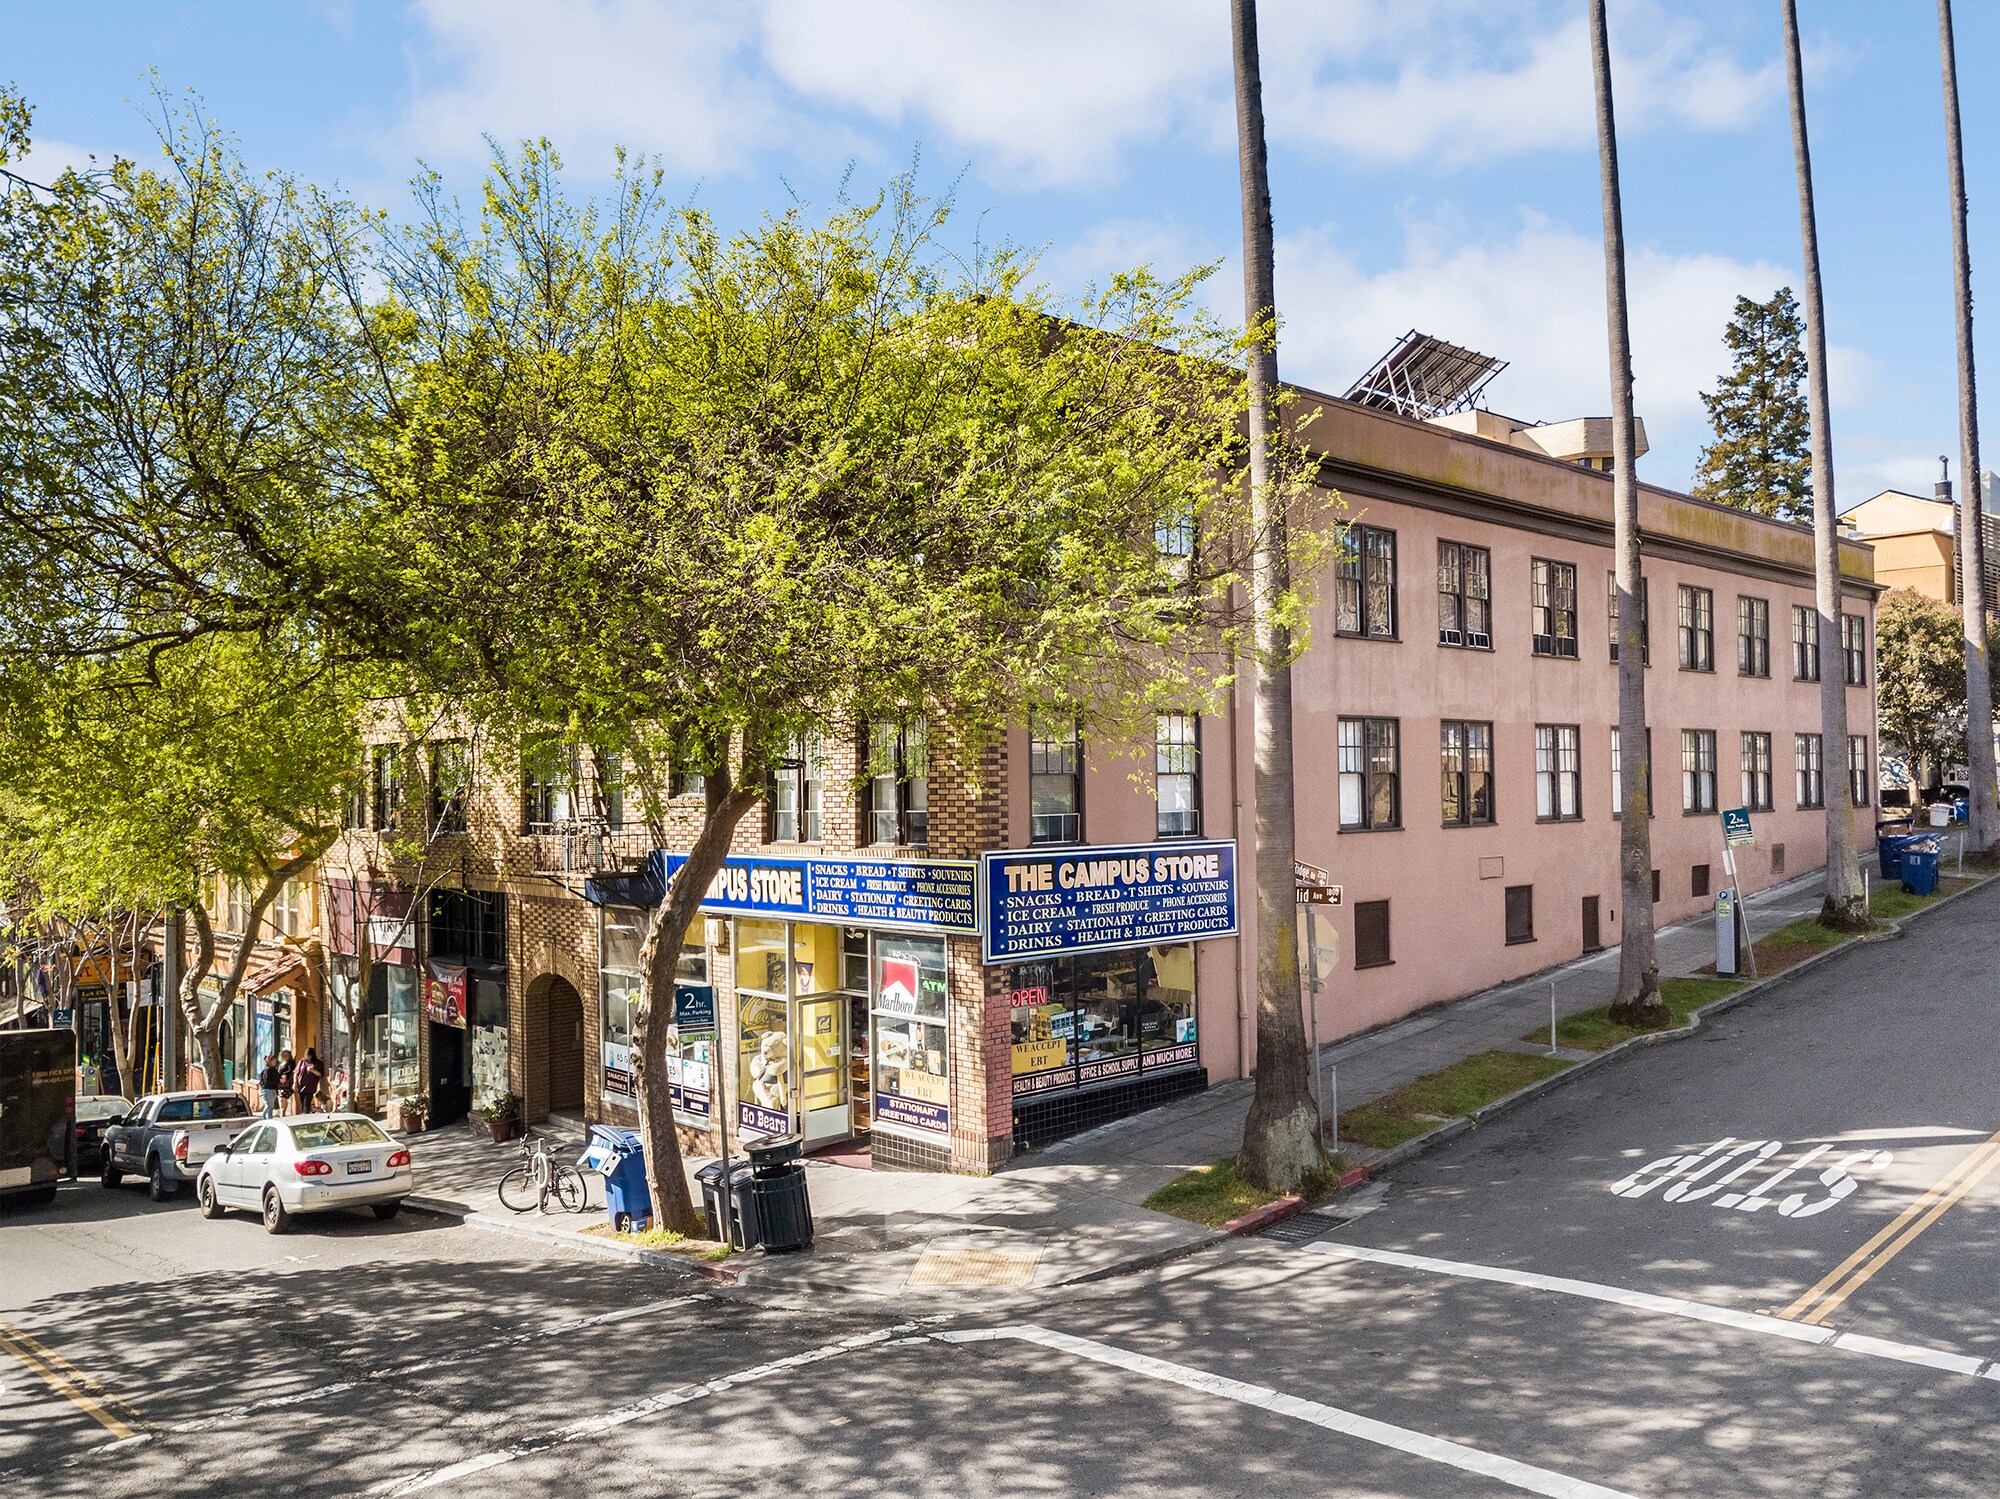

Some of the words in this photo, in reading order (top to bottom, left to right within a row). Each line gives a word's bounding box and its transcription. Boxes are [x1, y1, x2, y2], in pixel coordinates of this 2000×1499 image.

[1728, 812, 1737, 824] 2
[815, 865, 847, 876] SNACKS
[856, 866, 886, 877] BREAD
[891, 867, 897, 877] T
[898, 868, 926, 879] SHIRTS
[932, 869, 972, 881] SOUVENIRS
[1004, 864, 1053, 892] THE
[1058, 858, 1150, 889] CAMPUS
[1154, 854, 1219, 882] STORE
[704, 868, 748, 902] MPUS
[750, 870, 802, 904] STORE
[816, 877, 829, 887] ICE
[830, 878, 857, 889] CREAM
[866, 879, 882, 890] FRESH
[882, 880, 907, 892] PRODUCE
[916, 882, 935, 893] PHONE
[936, 884, 970, 895] ACCESSORIES
[1007, 893, 1061, 908] SNACKS
[1076, 889, 1120, 902] BREAD
[1128, 887, 1136, 897] T
[1138, 884, 1174, 897] SHIRTS
[1182, 880, 1229, 893] SOUVENIRS
[816, 889, 843, 900] DAIRY
[851, 892, 896, 905] STATIONARY
[903, 895, 943, 908] GREETING
[945, 898, 971, 910] CARDS
[1007, 910, 1029, 922] ICE
[1032, 906, 1076, 920] CREAM
[1092, 902, 1114, 914] FRESH
[1116, 900, 1149, 912] PRODUCE
[1163, 896, 1185, 907] PHONE
[1186, 893, 1227, 906] ACCESSORIES
[817, 903, 848, 914] DRINKS
[857, 906, 888, 917] HEALTH
[889, 908, 895, 918] &
[896, 908, 927, 920] BEAUTY
[928, 910, 972, 924] PRODUCTS
[1008, 922, 1052, 936] DAIRY
[1067, 915, 1134, 930] STATIONARY
[1144, 909, 1195, 923] GREETING
[1197, 906, 1228, 918] CARDS
[1008, 935, 1062, 951] DRINKS
[1078, 929, 1121, 942] HEALTH
[1124, 927, 1132, 938] &
[1135, 923, 1175, 936] BEAUTY
[1178, 917, 1229, 932] PRODUCTS
[923, 980, 946, 992] ATM
[685, 993, 695, 1009] 2
[695, 1000, 706, 1008] hr.
[879, 993, 913, 1014] Marlboro
[1011, 988, 1046, 1007] OPEN
[1016, 1044, 1031, 1053] WE
[1031, 1040, 1061, 1052] ACCEPT
[1030, 1055, 1048, 1067] EBT
[1142, 1054, 1155, 1067] AND
[1156, 1051, 1174, 1064] MUCH
[1175, 1048, 1192, 1060] MORE
[607, 1071, 627, 1082] SNACKS
[905, 1071, 916, 1080] WE
[919, 1074, 945, 1086] ACCEPT
[1080, 1066, 1097, 1079] OFFICE
[1102, 1062, 1121, 1075] SCHOOL
[1121, 1058, 1139, 1071] SUPPLY
[607, 1080, 627, 1090] DRINKS
[1013, 1078, 1031, 1093] HEALTH
[1036, 1076, 1053, 1089] BEAUTY
[1053, 1070, 1076, 1085] PRODUCTS
[918, 1087, 932, 1098] EBT
[890, 1099, 938, 1117] STATIONARY
[743, 1107, 754, 1124] Go
[757, 1111, 786, 1133] Bears
[879, 1108, 918, 1124] GREETING
[920, 1117, 947, 1131] CARDS
[1610, 1137, 1894, 1218] STOP
